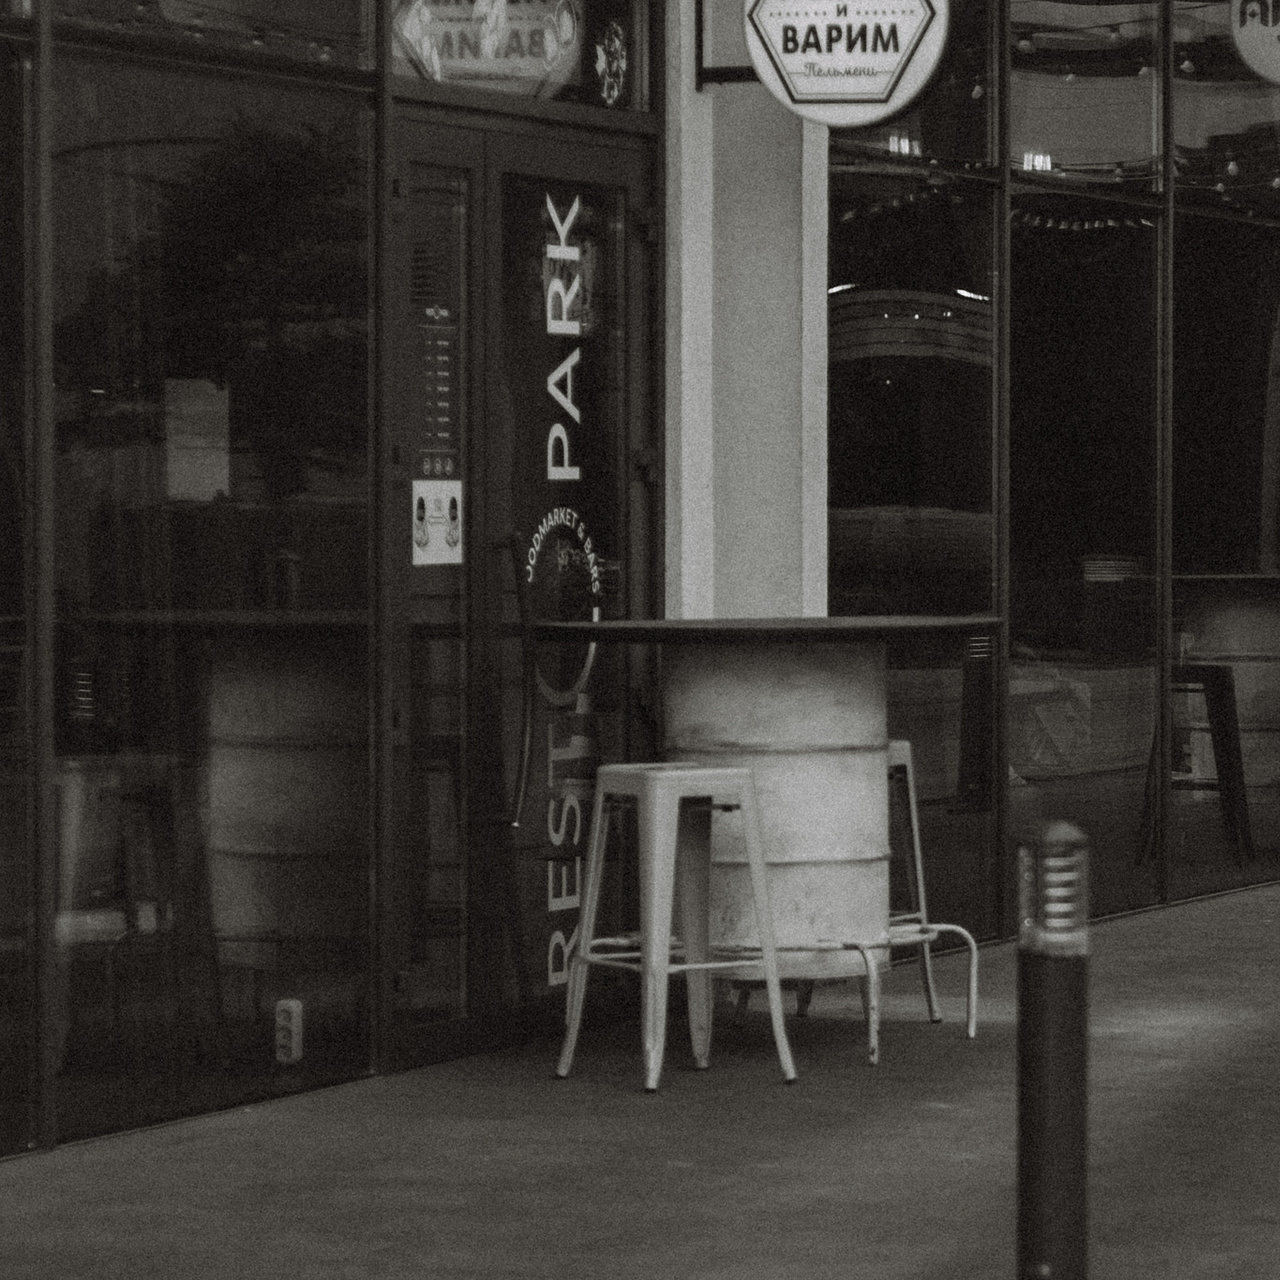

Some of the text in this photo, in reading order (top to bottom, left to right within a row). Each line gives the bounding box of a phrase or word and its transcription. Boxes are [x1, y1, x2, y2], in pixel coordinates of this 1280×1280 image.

[782, 23, 899, 54] ВАРИМ
[804, 63, 878, 77] Пельмени
[546, 191, 582, 481] PARK
[583, 536, 601, 594] BARS
